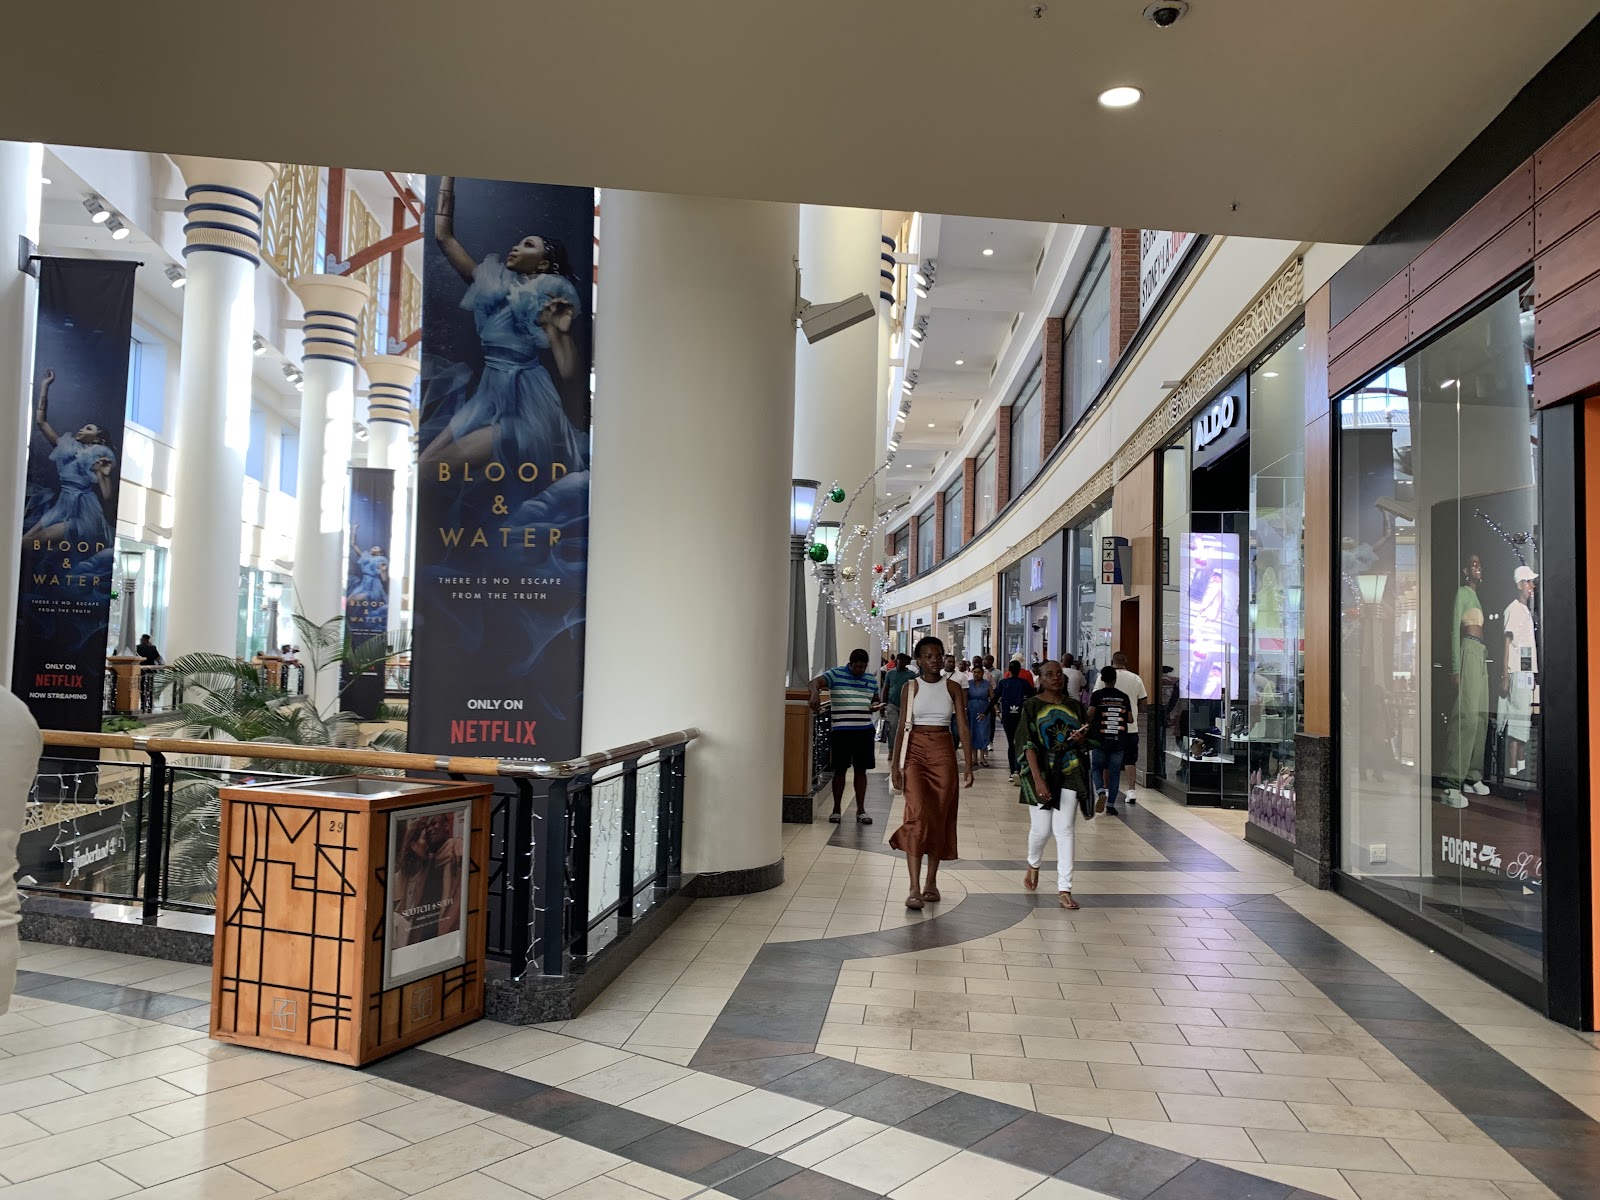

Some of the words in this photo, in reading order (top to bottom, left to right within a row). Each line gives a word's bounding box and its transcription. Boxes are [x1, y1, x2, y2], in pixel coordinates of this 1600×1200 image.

[1194, 396, 1234, 452] ALDO
[438, 462, 568, 482] BLOOD
[492, 494, 508, 514] &
[33, 540, 104, 552] BLOOD
[439, 527, 562, 548] WATER
[62, 558, 72, 568] &
[32, 574, 100, 586] WATER
[35, 674, 83, 688] NETFLIX
[467, 699, 501, 710] ONLY
[503, 700, 523, 710] ON
[451, 720, 537, 746] NETFLIX
[329, 820, 343, 833] 29
[1442, 835, 1478, 869] FORCE
